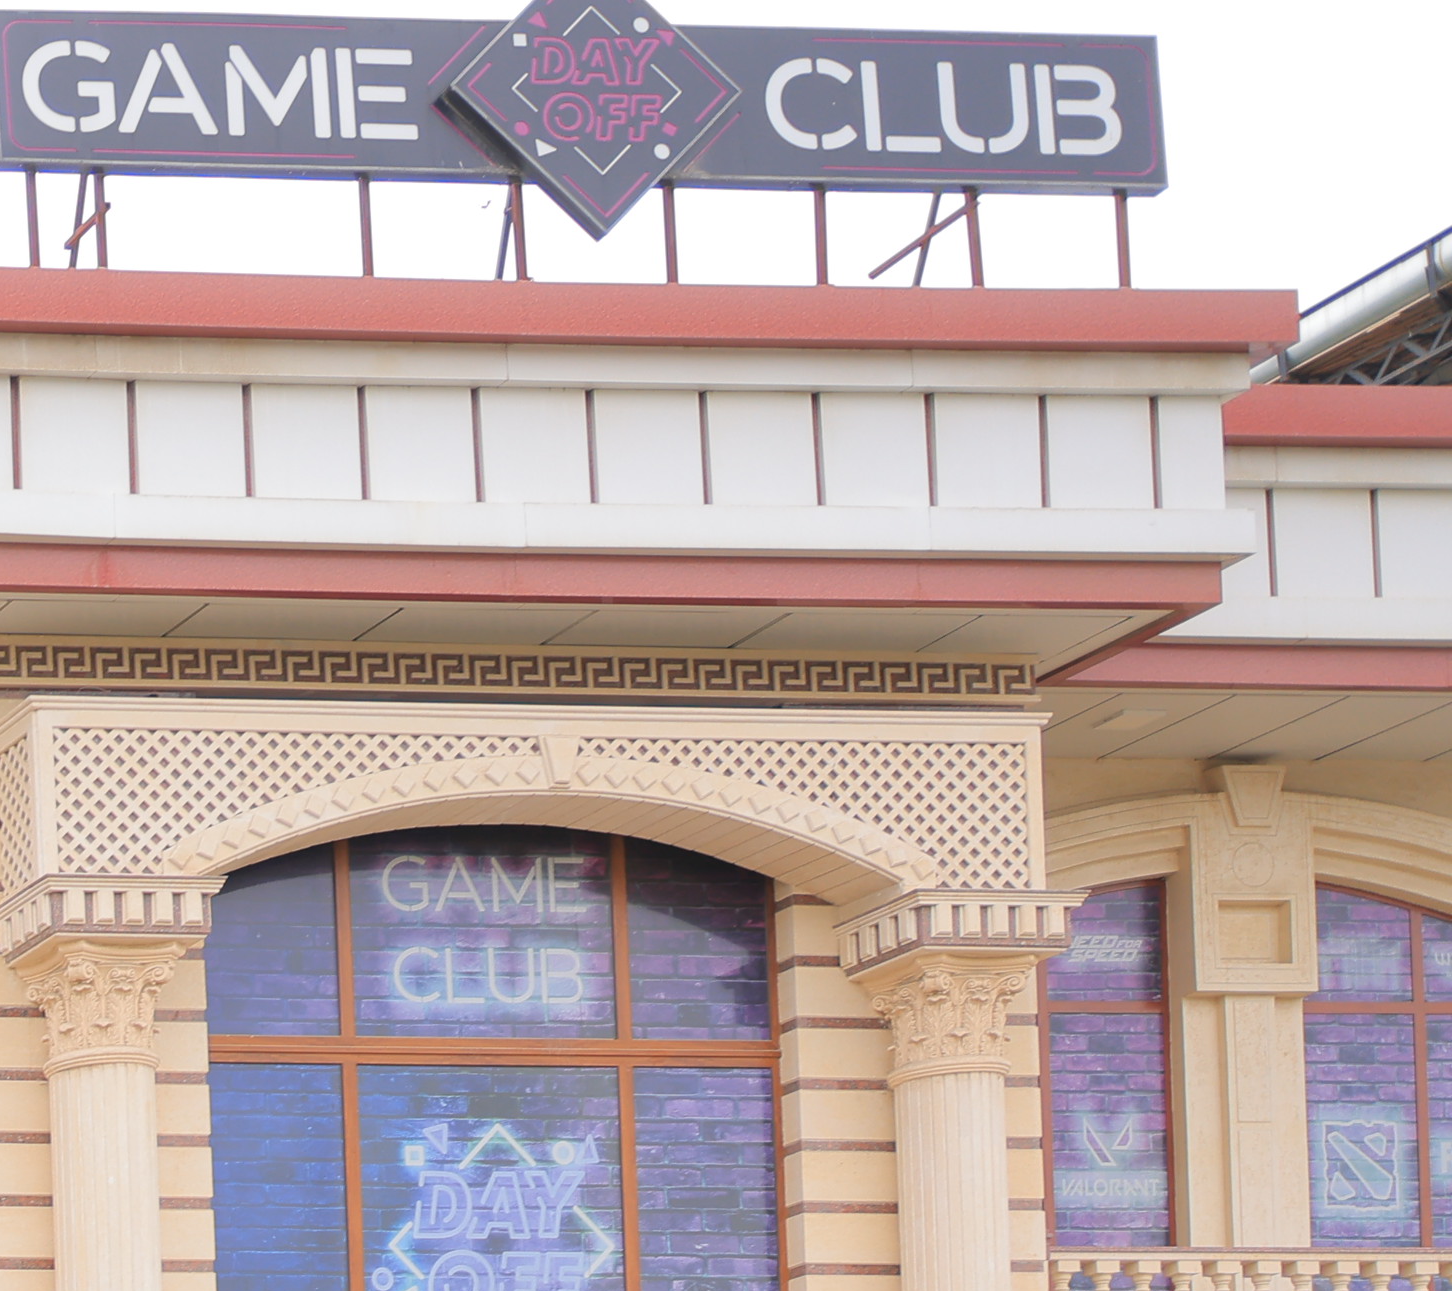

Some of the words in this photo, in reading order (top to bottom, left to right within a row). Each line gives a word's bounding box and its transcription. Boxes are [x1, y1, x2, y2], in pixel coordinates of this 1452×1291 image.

[532, 36, 661, 85] DAY
[22, 40, 419, 140] GAME
[765, 57, 1123, 156] CLUB
[542, 92, 664, 142] OFF
[381, 855, 588, 915] GAME
[392, 947, 585, 1005] CLUB
[1068, 949, 1139, 962] SPEED
[413, 1171, 585, 1240] DAY
[1062, 1179, 1161, 1197] VALORANT
